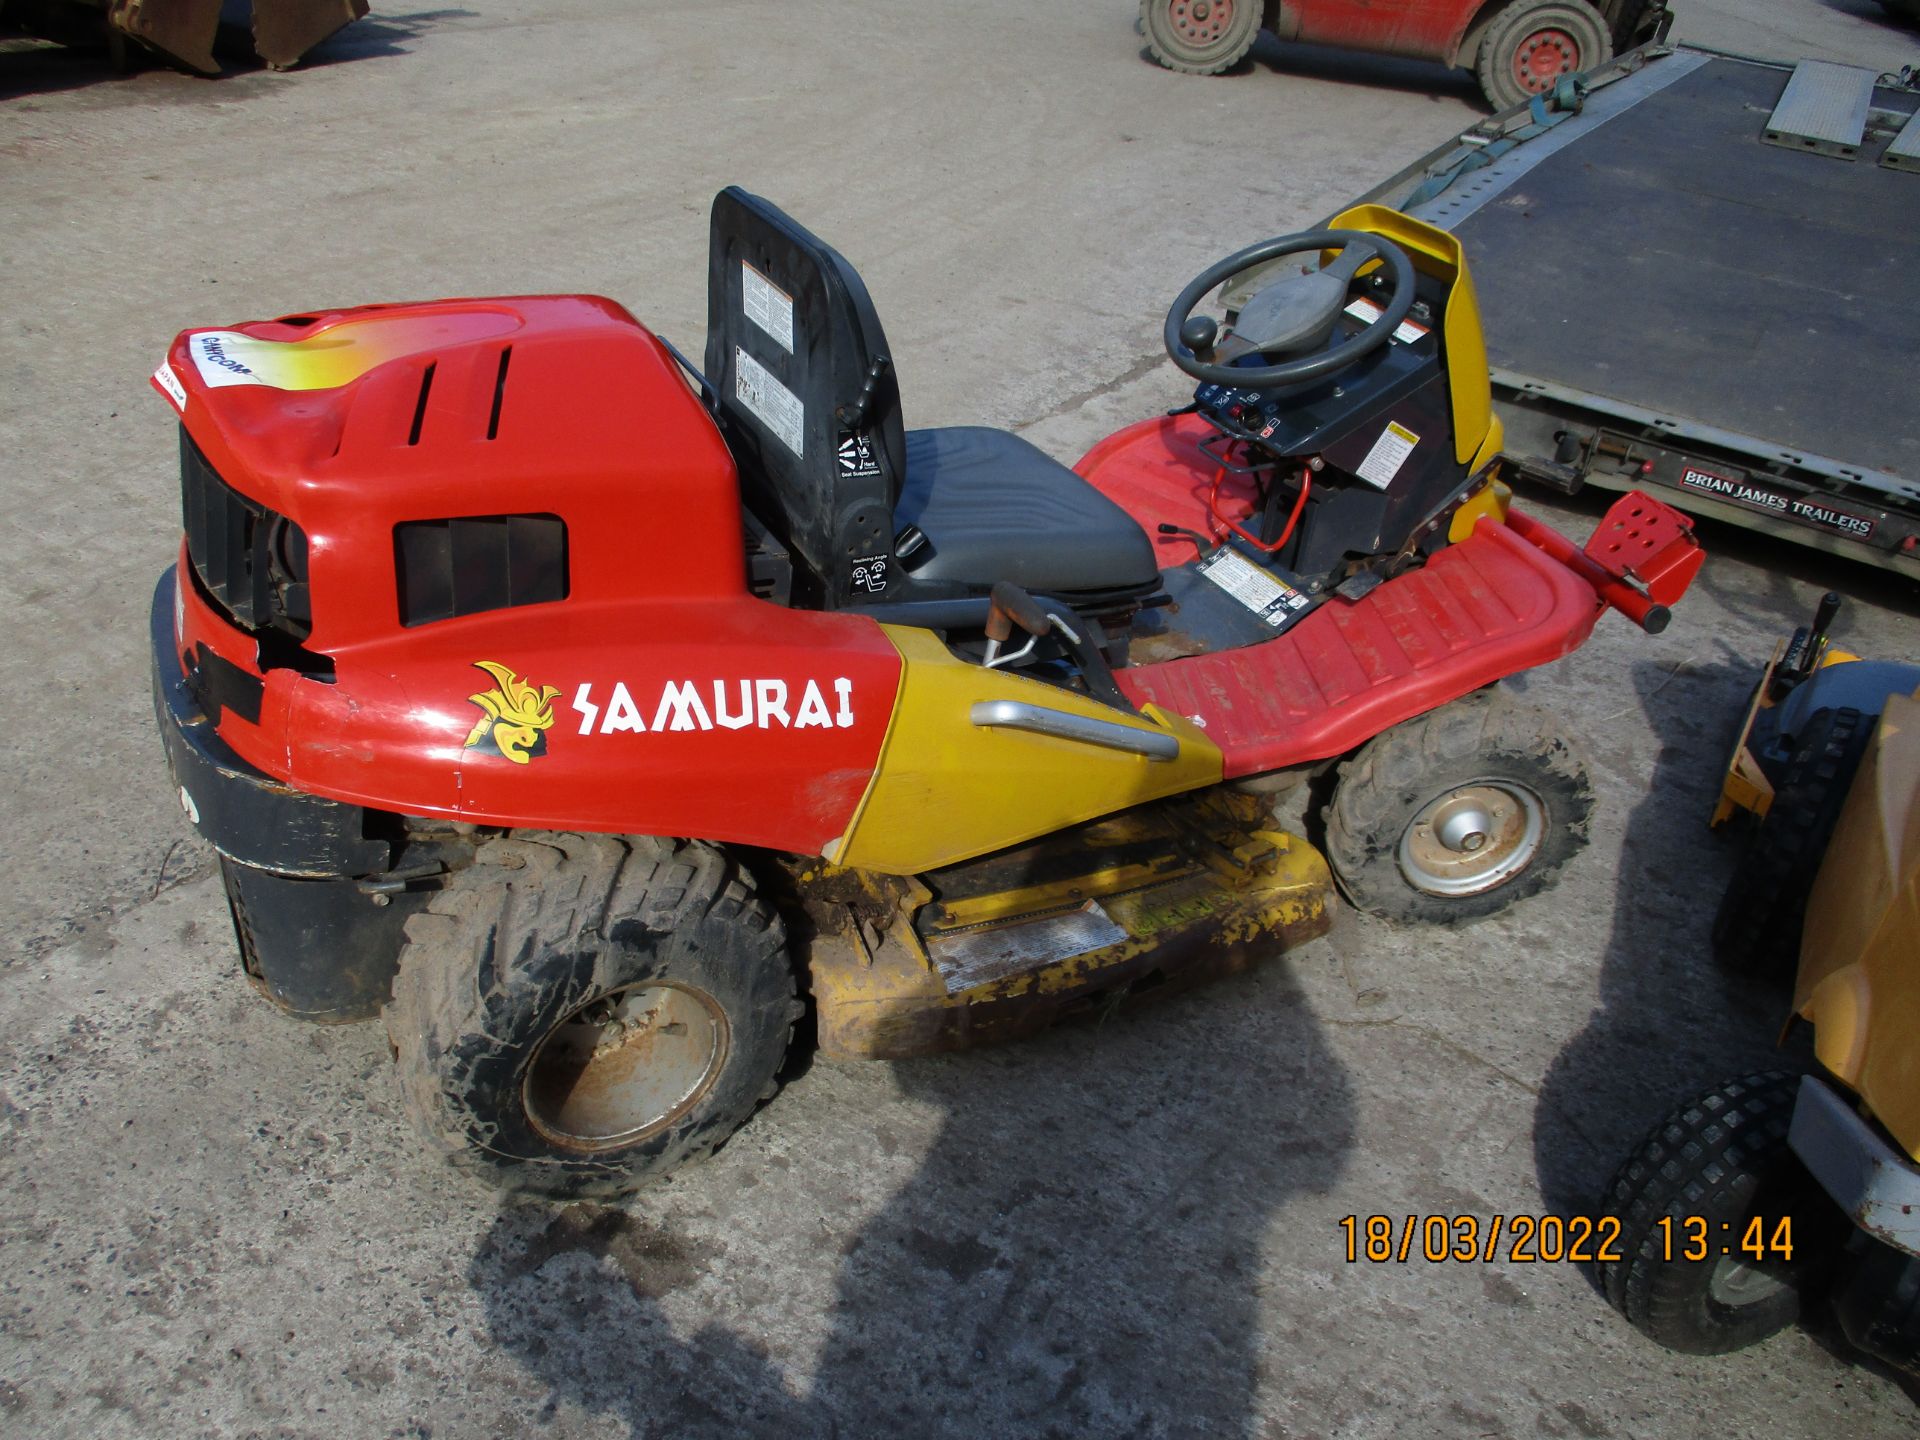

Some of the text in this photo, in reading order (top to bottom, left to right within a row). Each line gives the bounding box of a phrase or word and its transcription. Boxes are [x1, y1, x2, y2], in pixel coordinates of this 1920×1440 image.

[1684, 470, 1734, 493] BRIAN
[1733, 486, 1788, 508] JAMES
[1792, 501, 1871, 533] TRAILERS
[572, 677, 854, 735] SAMURAI
